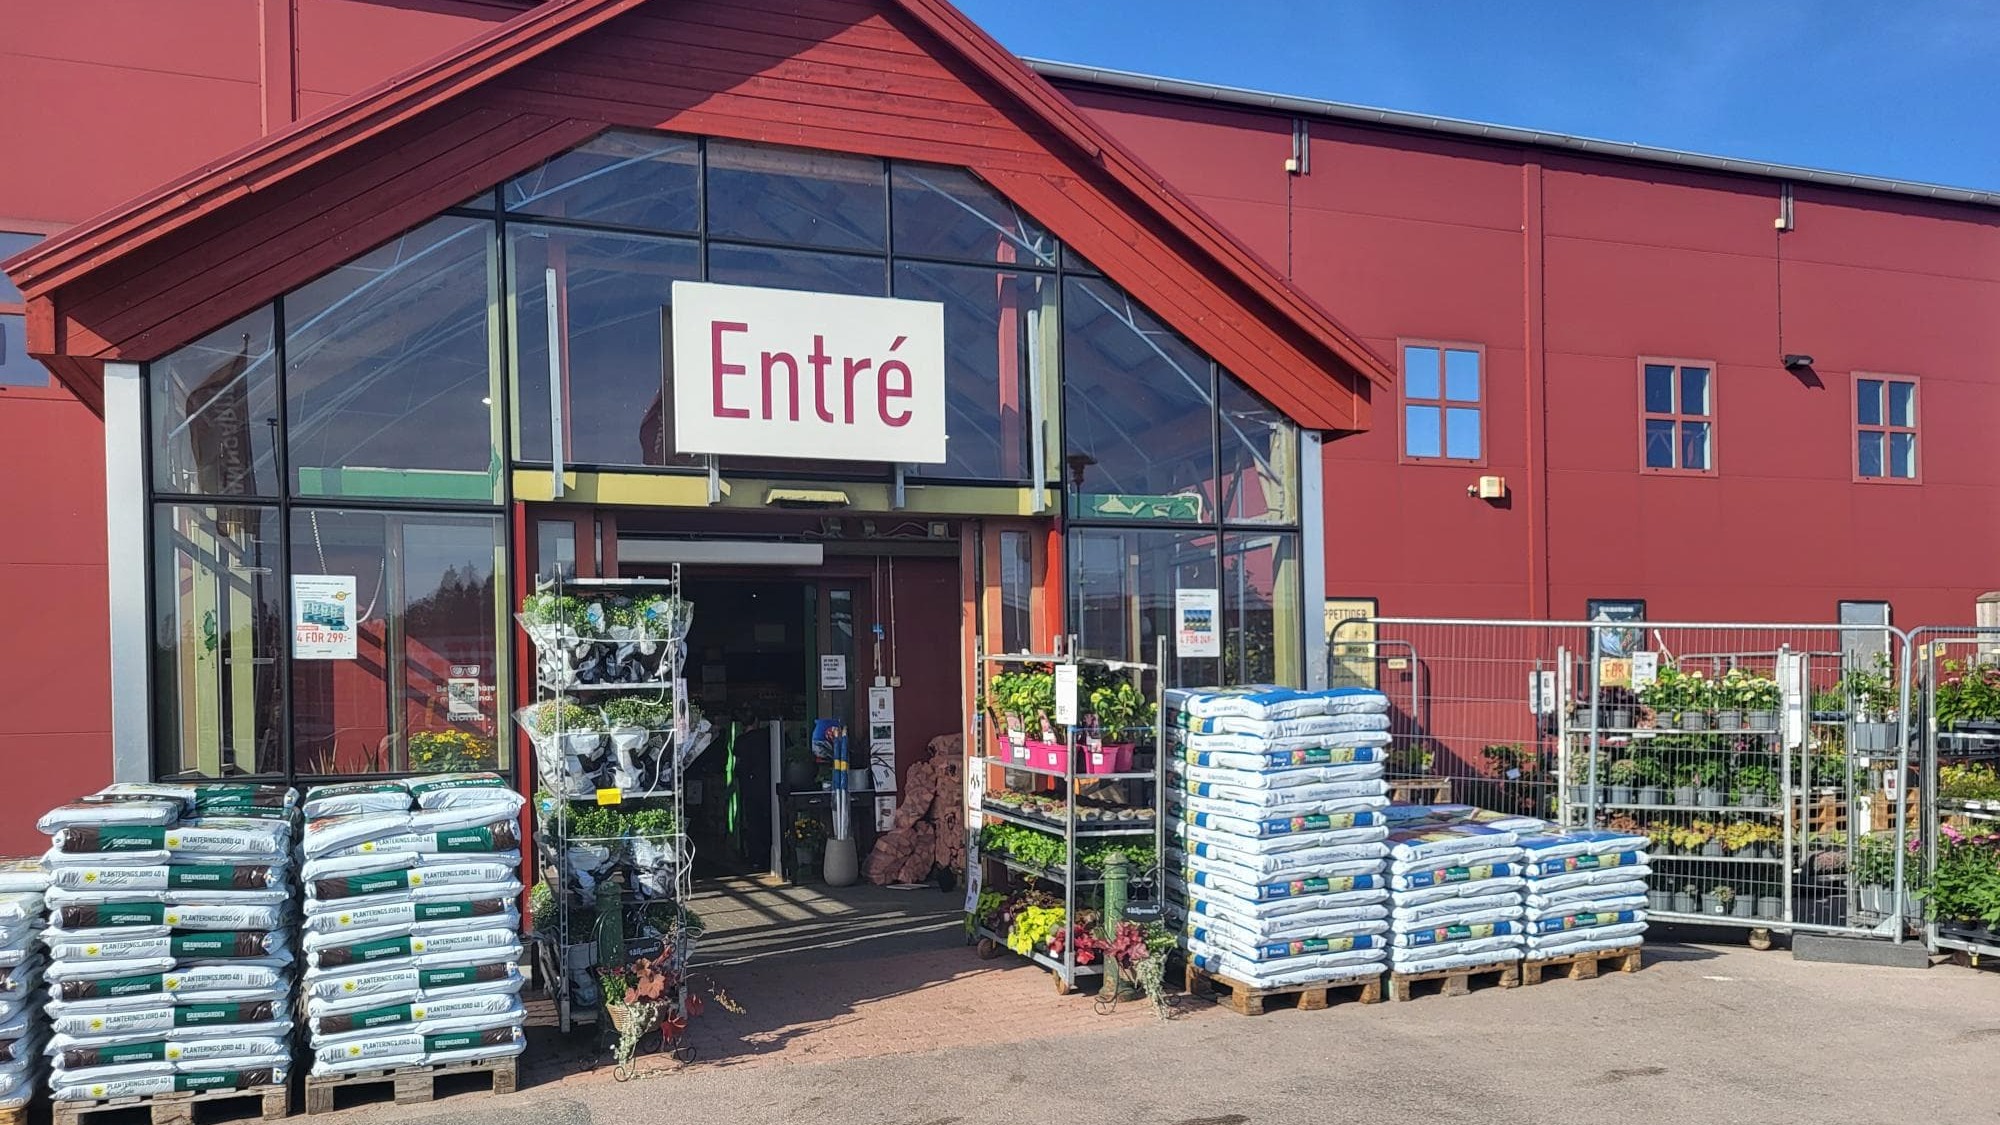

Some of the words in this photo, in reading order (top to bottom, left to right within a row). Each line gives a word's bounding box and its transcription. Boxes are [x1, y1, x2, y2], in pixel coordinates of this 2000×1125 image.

[711, 320, 913, 427] Entré
[182, 836, 234, 845] PLANTERINGSJORD
[100, 870, 152, 878] PLANTERINGSJORD
[154, 870, 160, 878] 40
[424, 870, 469, 879] PLANTERINGSJORD
[181, 914, 232, 922] PLANTERINGSJORD
[232, 914, 240, 922] 40
[352, 908, 400, 918] PLANTERINGSJORD
[102, 940, 154, 950] PLANTERINGSJORD
[426, 936, 472, 947] PLANTERINGSJORD
[180, 974, 232, 982] PLANTERINGSJORD
[232, 973, 239, 981] 40
[357, 974, 405, 985] PLANTERINGSJORD
[427, 1004, 473, 1013] PLANTERINGSJORD
[106, 1013, 158, 1024] PLANTERINGSJORD
[182, 1044, 234, 1054] PLANTERINGSJORD
[363, 1040, 410, 1050] PLANTERINGSJORD
[106, 1080, 159, 1090] PLANTERINGSJORD
